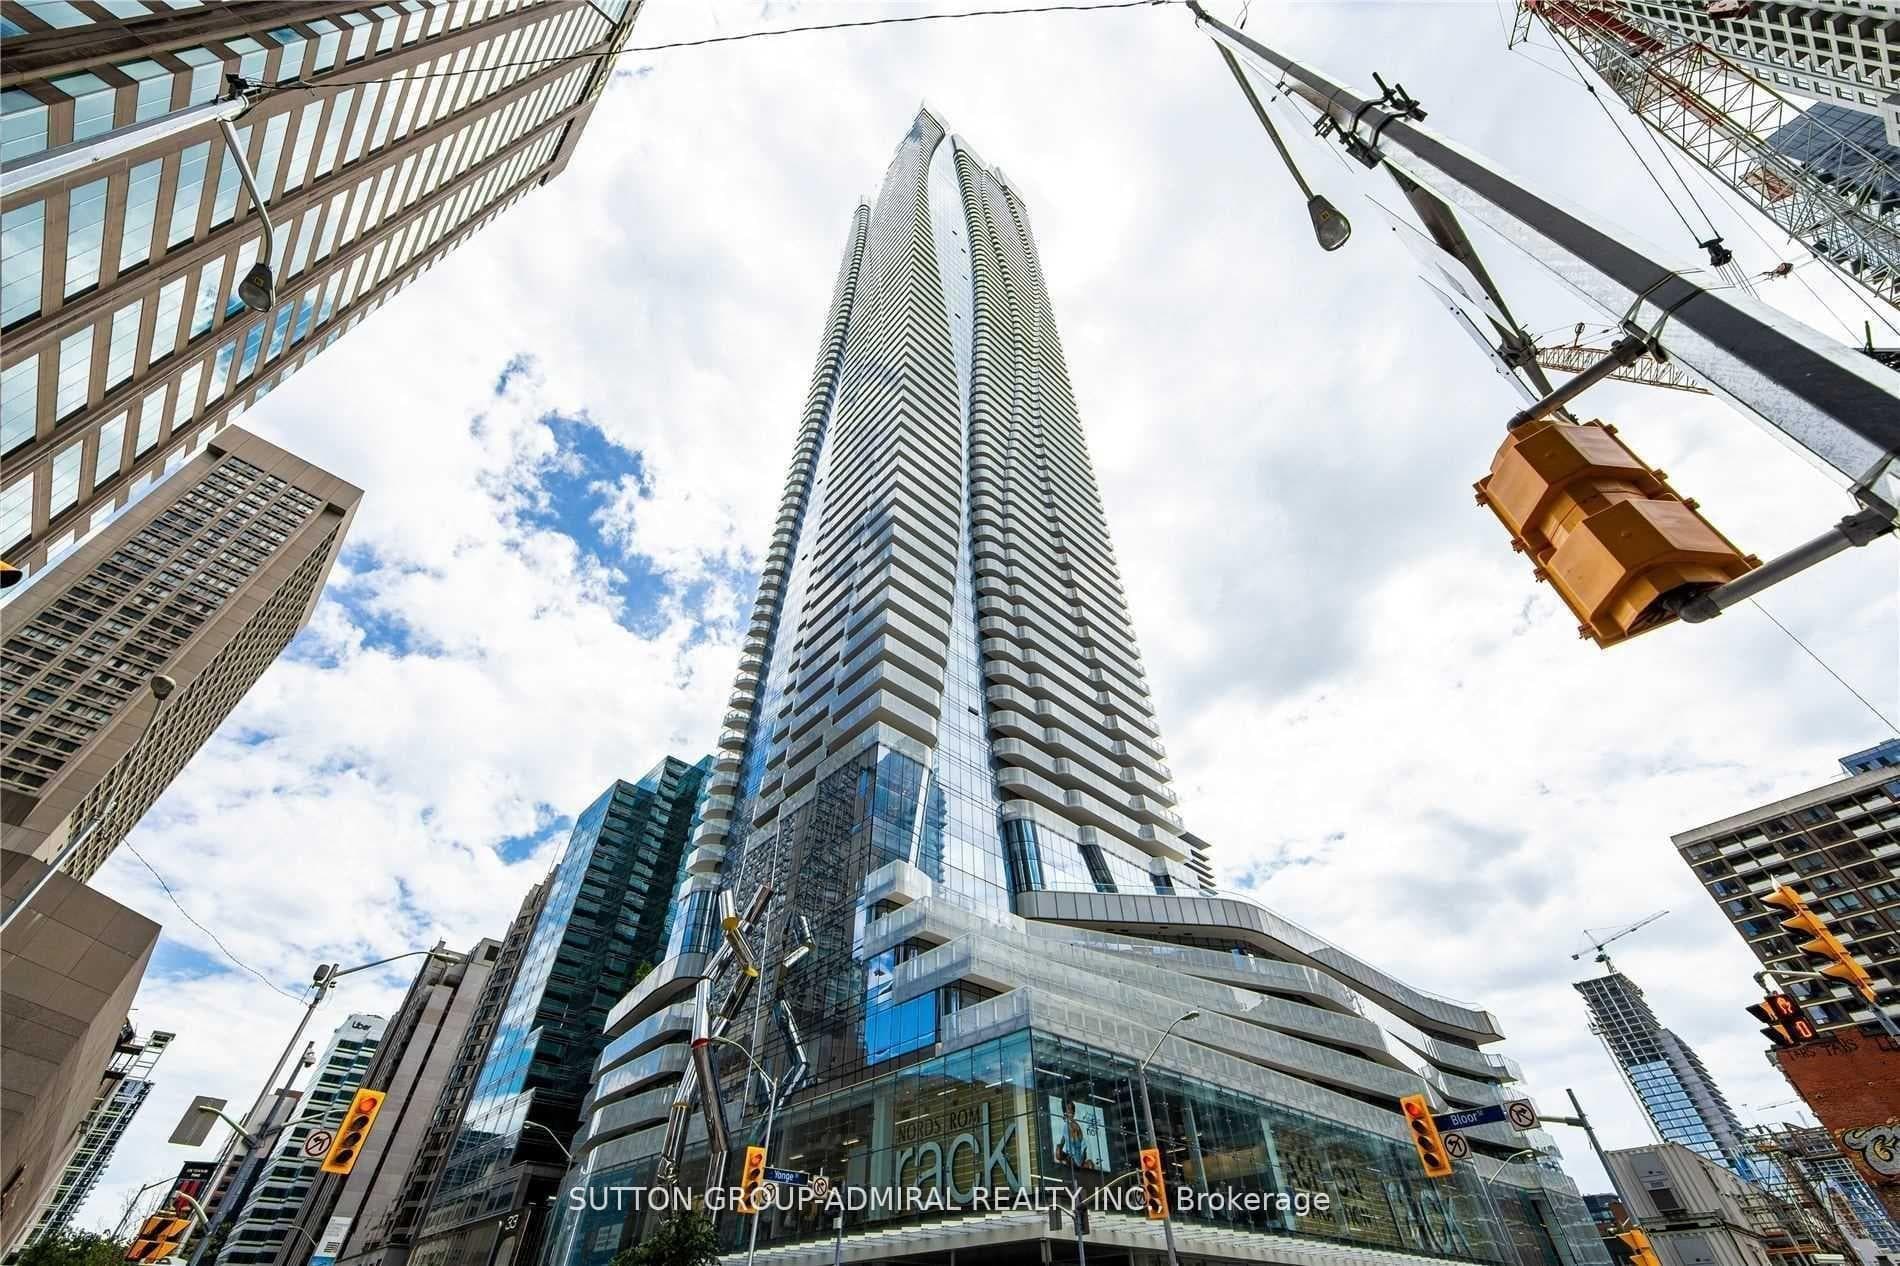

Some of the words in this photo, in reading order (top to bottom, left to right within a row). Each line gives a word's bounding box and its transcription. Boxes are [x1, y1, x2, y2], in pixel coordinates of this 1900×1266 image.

[352, 1020, 372, 1031] Uber
[897, 1107, 982, 1142] NORDSROM
[1450, 1113, 1478, 1126] Bloor
[895, 1102, 1022, 1213] rack
[774, 1170, 795, 1184] Yonge
